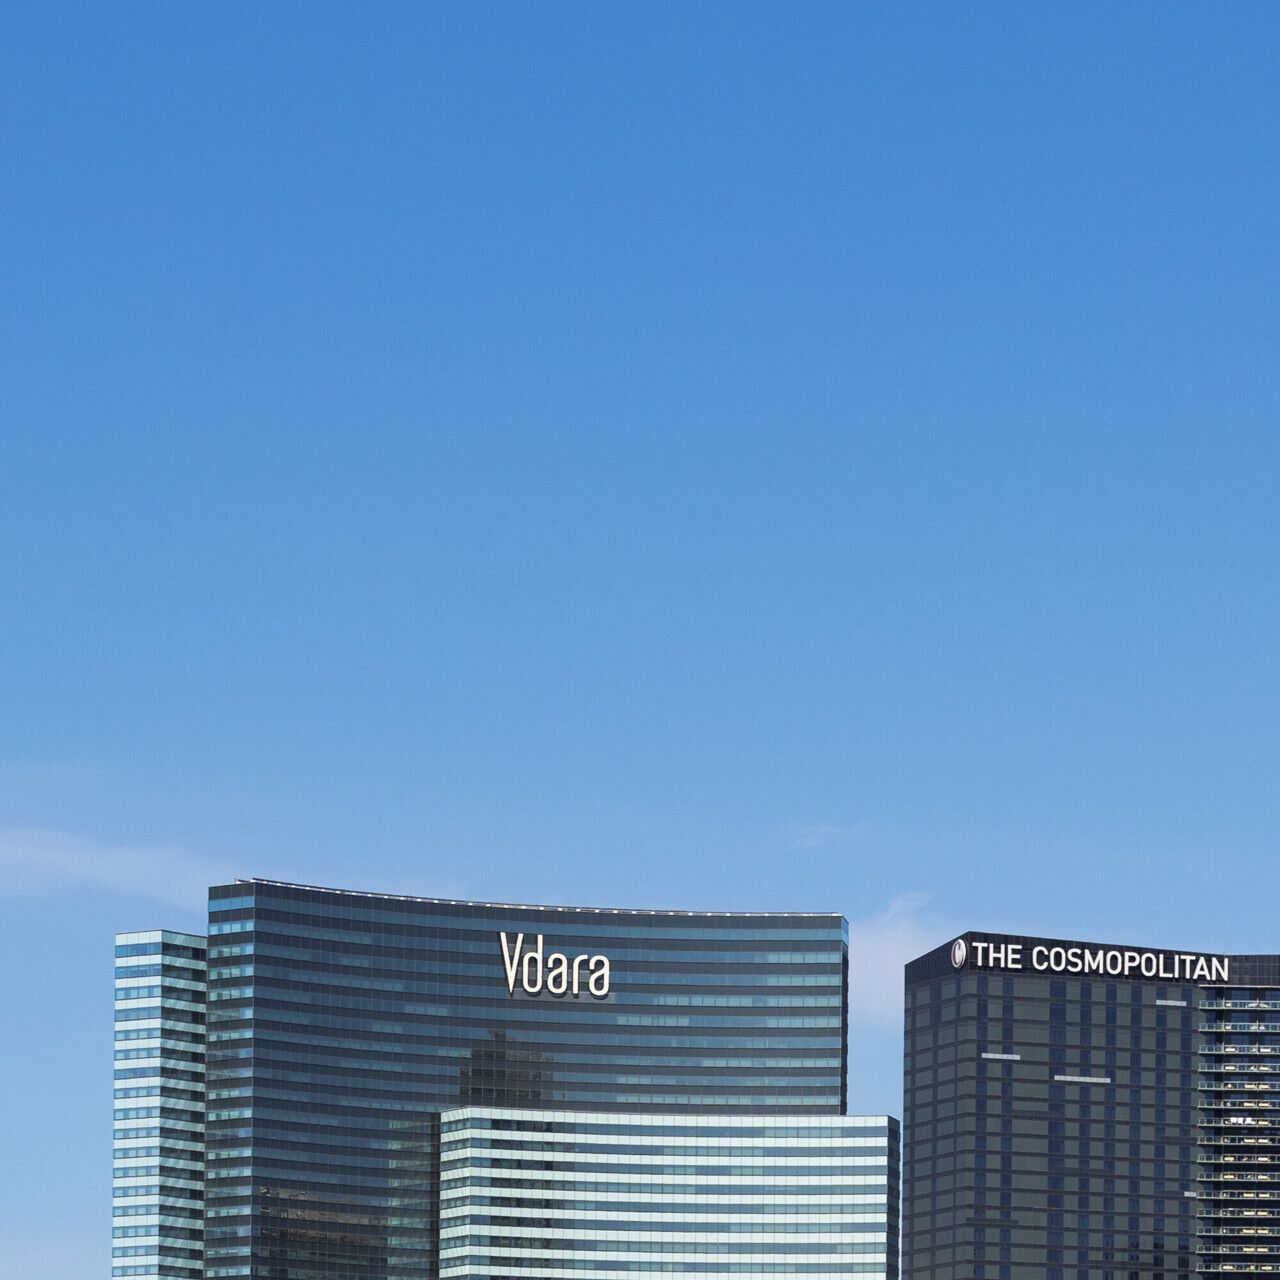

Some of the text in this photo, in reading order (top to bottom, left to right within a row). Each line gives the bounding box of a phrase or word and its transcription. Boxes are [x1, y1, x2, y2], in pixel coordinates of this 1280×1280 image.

[500, 931, 610, 996] Vdara
[972, 941, 1229, 981] THE COSMOPOLITAN
